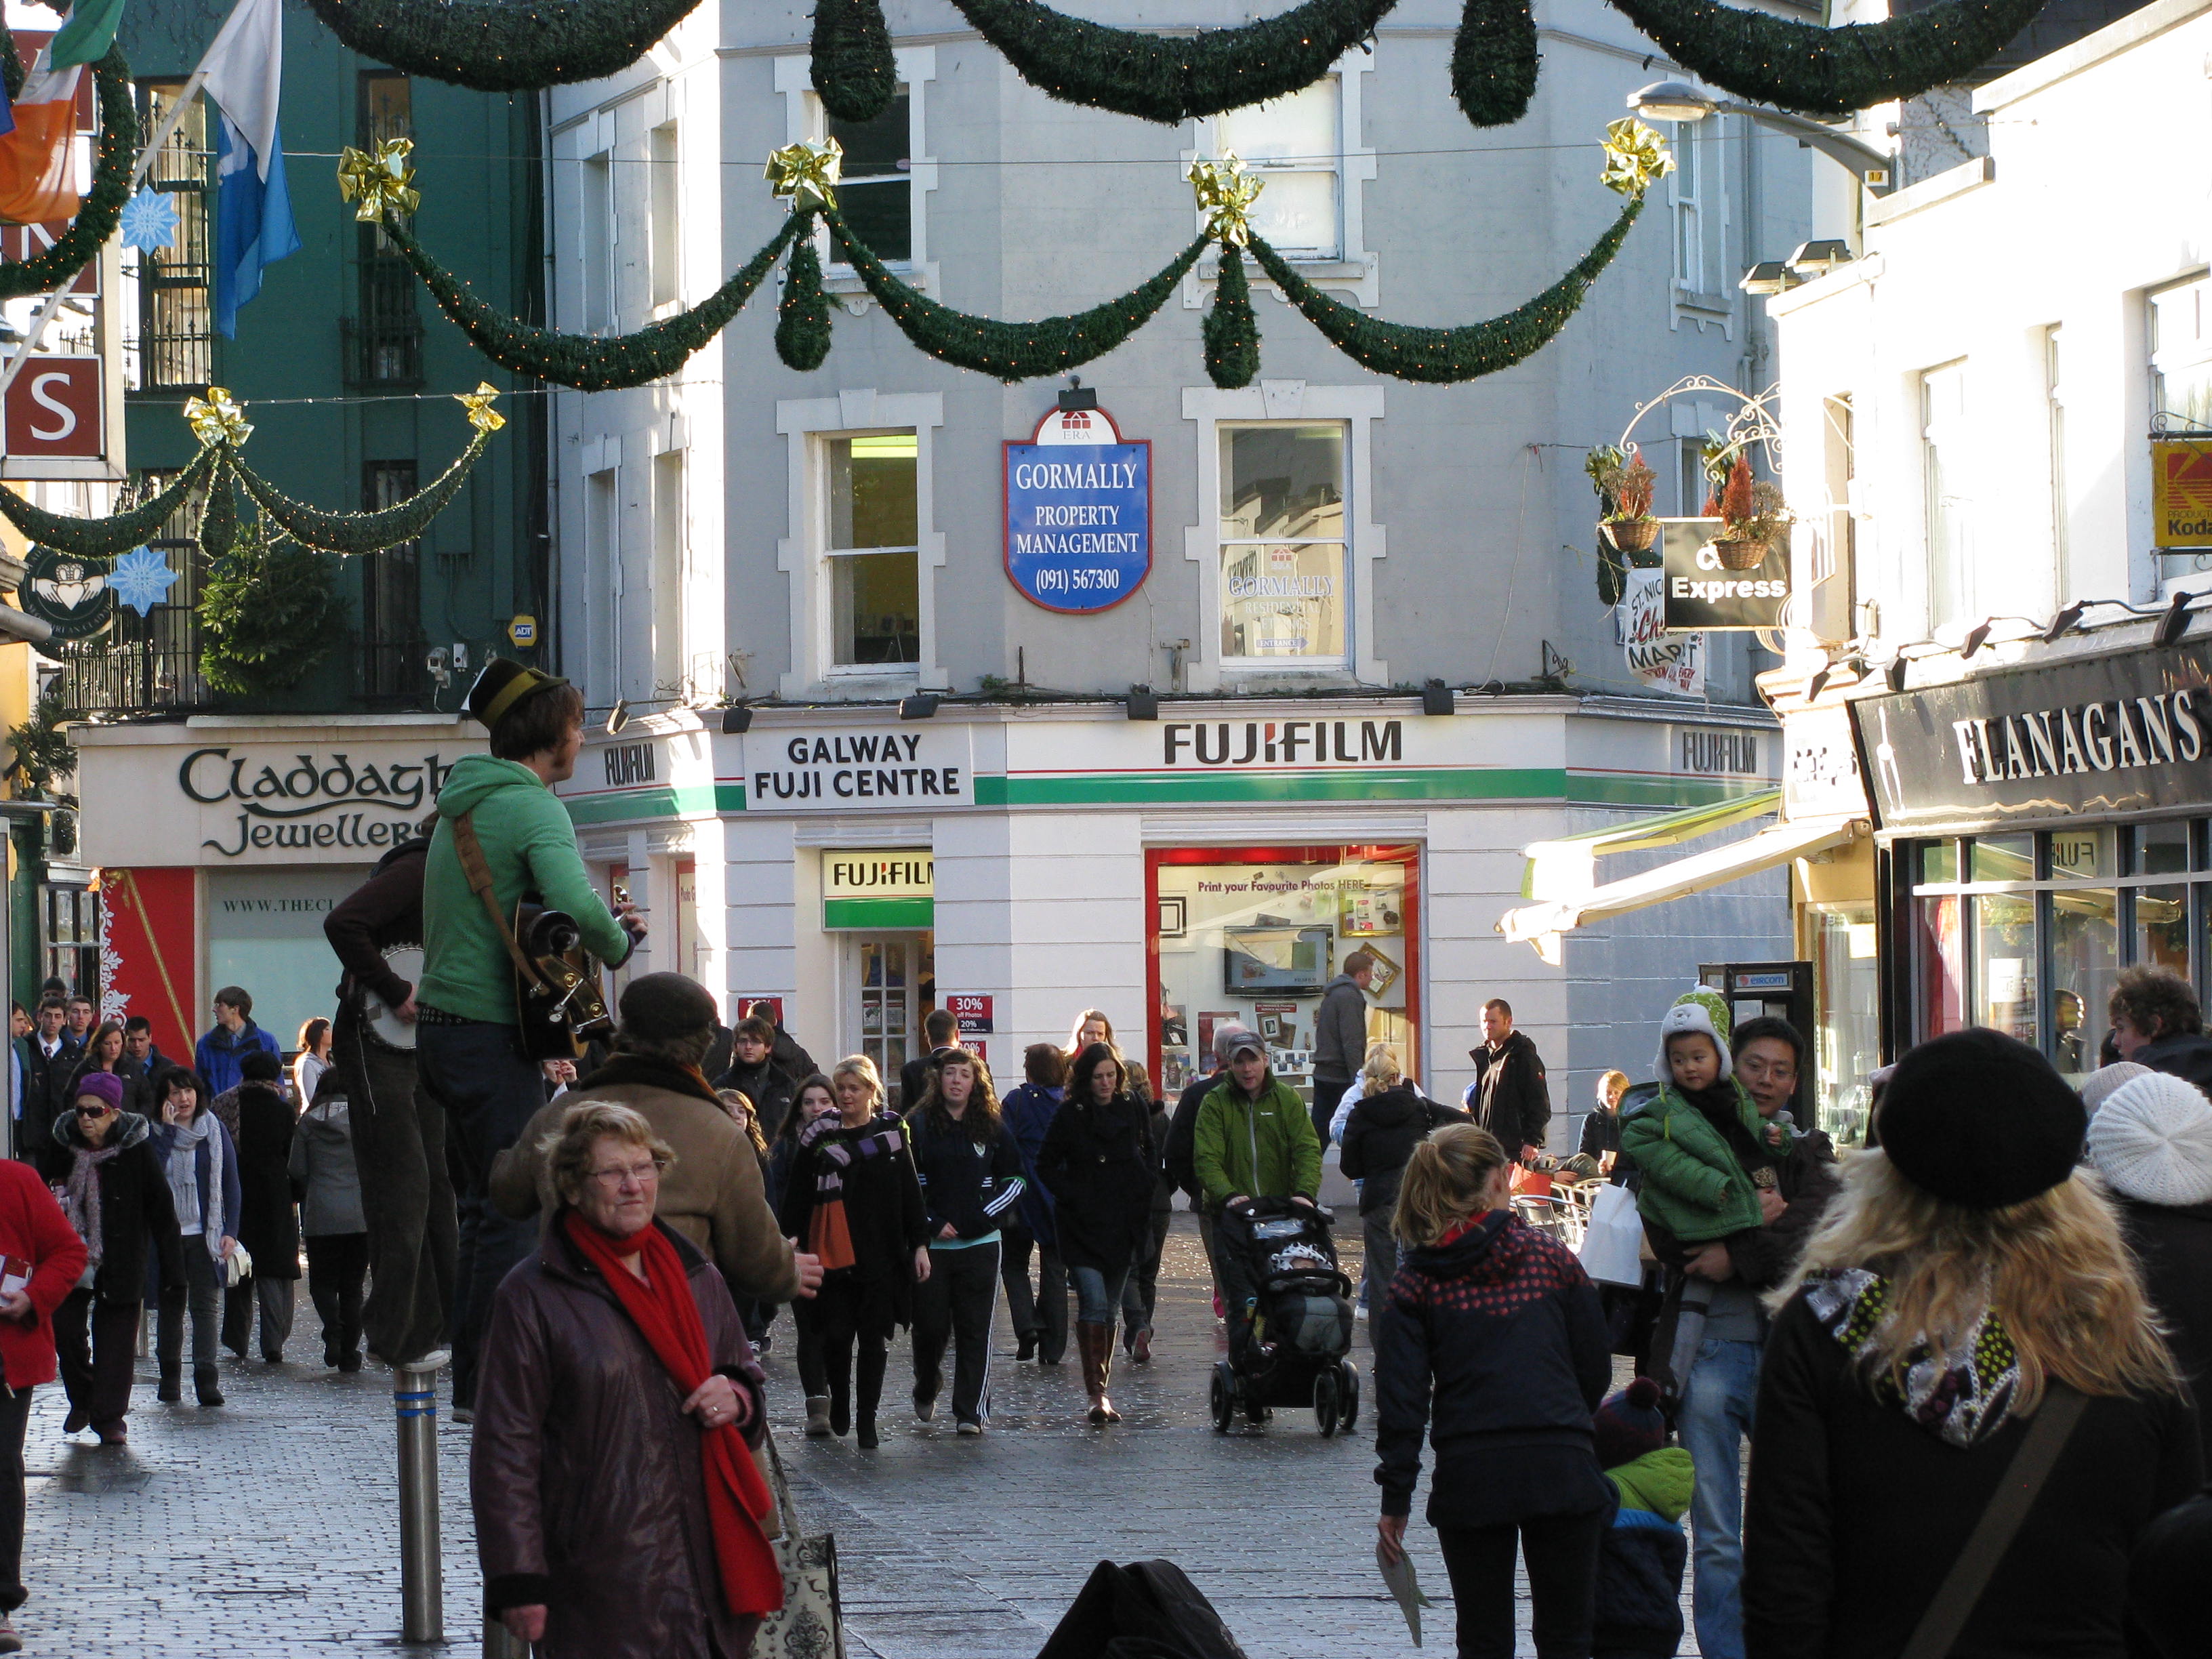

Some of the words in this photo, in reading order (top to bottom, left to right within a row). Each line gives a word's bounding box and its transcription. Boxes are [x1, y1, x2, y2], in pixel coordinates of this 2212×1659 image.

[1063, 430, 1091, 440] ERA
[1016, 463, 1137, 489] GORMALLY
[1035, 506, 1120, 527] PROPERTY
[1016, 533, 1139, 554] MANAGEMENT
[1036, 569, 1069, 596] (091)
[1072, 569, 1120, 590] 567300
[1229, 575, 1336, 597] GORMALLY
[1671, 576, 1787, 604] Express
[515, 627, 532, 636] ADT
[1259, 639, 1298, 647] ENTRANCE
[1164, 720, 1401, 764] FUJIFILM
[1952, 689, 2203, 785] FLANAGANS
[787, 734, 922, 764] GALWAY
[1683, 732, 1757, 773] FUJIFILM
[755, 771, 821, 799] FUJI
[833, 767, 960, 798] CENTRE
[1197, 882, 1222, 892] Print
[1225, 882, 1248, 895] your
[1251, 880, 1298, 892] Favourite
[1301, 880, 1335, 890] Photos
[1338, 879, 1365, 890] HERE
[956, 998, 983, 1010] 30%
[960, 1019, 977, 1027] 20%
